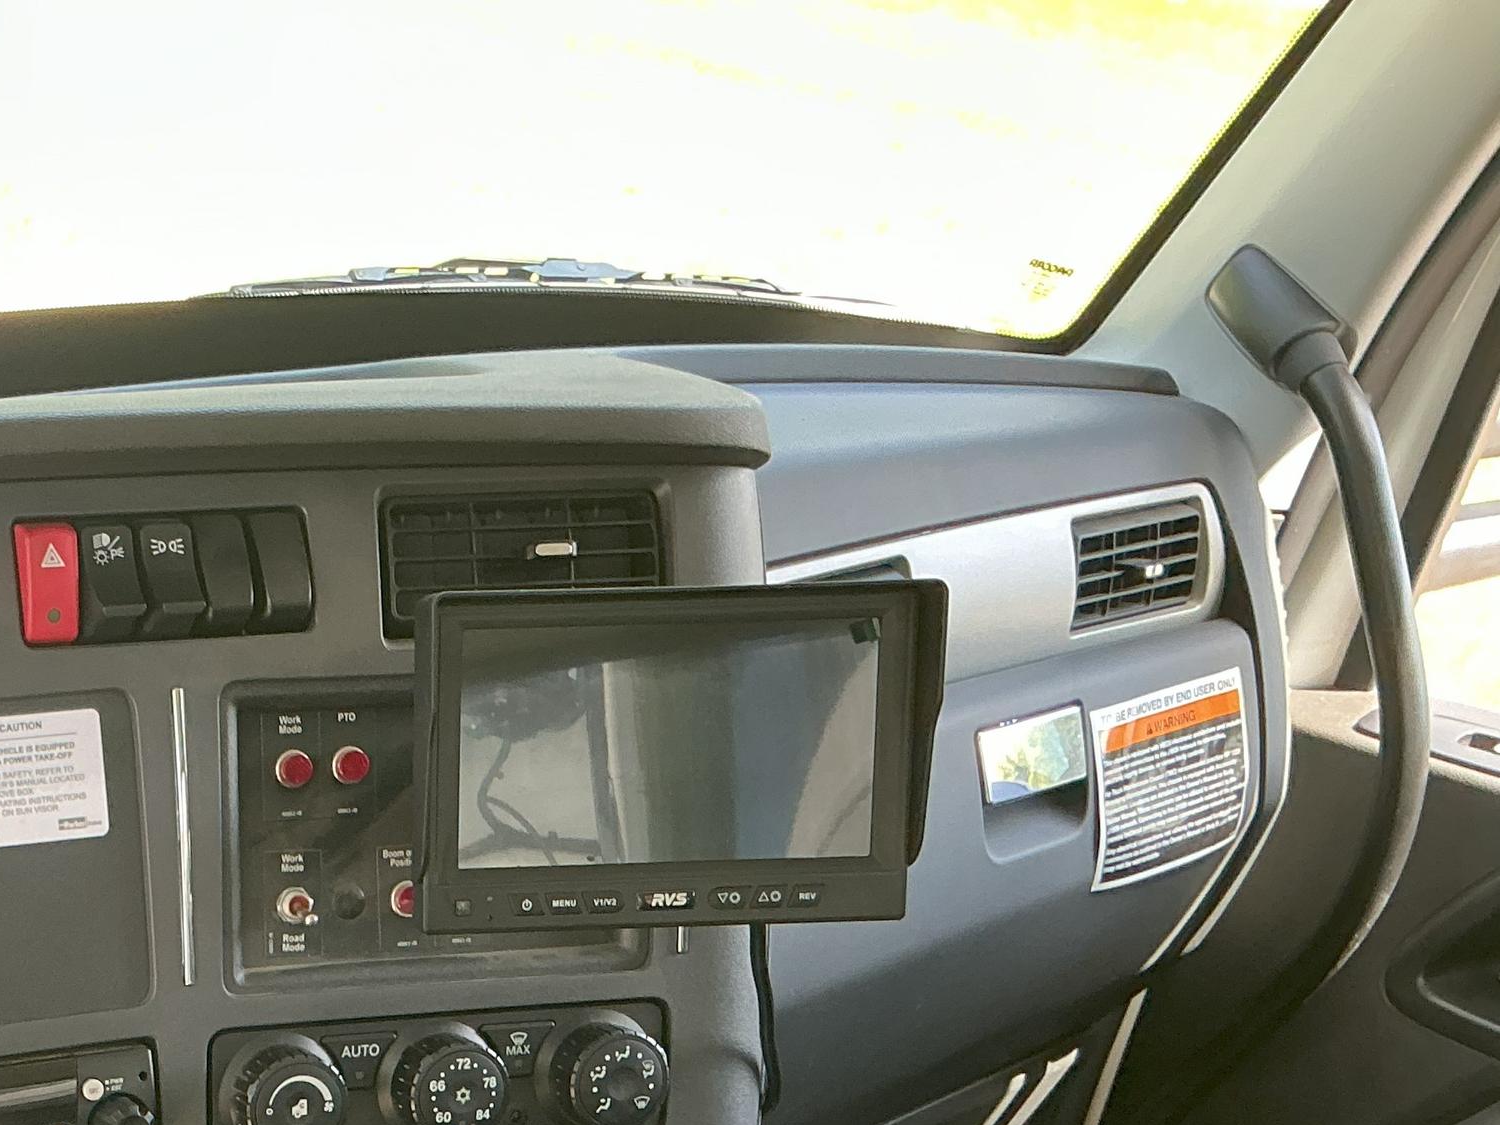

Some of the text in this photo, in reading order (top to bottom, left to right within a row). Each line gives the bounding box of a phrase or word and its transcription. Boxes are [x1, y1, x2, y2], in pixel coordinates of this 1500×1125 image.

[1116, 711, 1126, 722] BE
[1164, 695, 1174, 706] BY
[1176, 689, 1191, 702] END
[1194, 682, 1215, 697] USER
[1217, 677, 1235, 691] ONLY
[278, 715, 302, 725] Work
[337, 712, 356, 722] PTO
[1153, 710, 1196, 731] WARNING
[0, 721, 43, 733] CAUTION
[278, 725, 303, 734] Mode
[35, 741, 75, 752] EQUIPPED
[3, 756, 33, 765] POWER
[35, 752, 72, 761] TAKE-OFF
[35, 767, 62, 776] REFER
[16, 777, 47, 787] MANUAL
[49, 774, 85, 784] LOCATED
[17, 788, 34, 796] BOX
[29, 792, 87, 804] INSTRUCTIONS
[2, 809, 14, 817] ON
[34, 804, 58, 814] VISOR
[281, 854, 304, 864] Work
[382, 849, 404, 859] Boom
[281, 863, 304, 873] Mode
[651, 892, 688, 907] RVS
[799, 892, 816, 900] REV
[552, 899, 577, 908] MENU
[282, 933, 305, 943] Road
[282, 942, 306, 952] Mode
[341, 1043, 380, 1058] AUTO
[505, 1044, 531, 1056] MAX
[456, 1058, 471, 1070] 72
[429, 1080, 446, 1092] 66
[482, 1076, 497, 1089] 78
[435, 1111, 452, 1123] 60
[475, 1108, 491, 1121] 84
